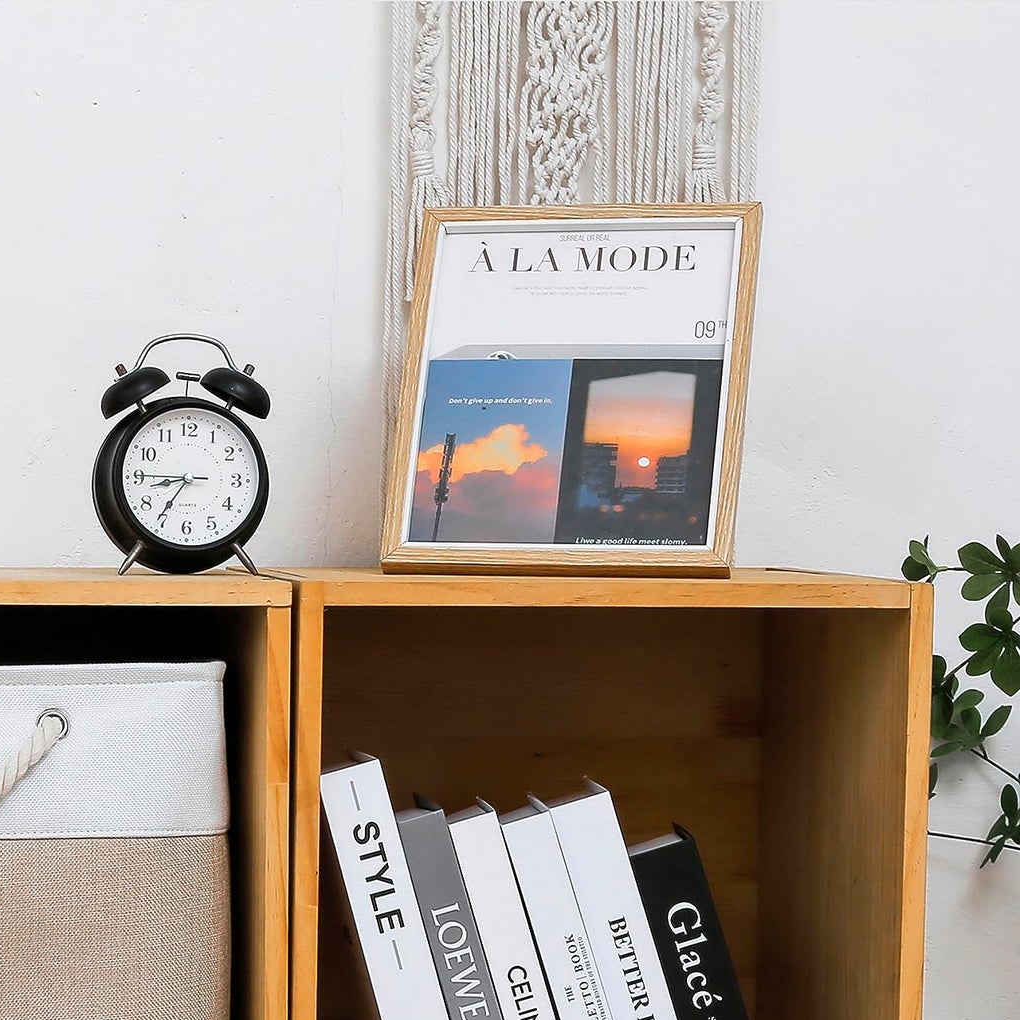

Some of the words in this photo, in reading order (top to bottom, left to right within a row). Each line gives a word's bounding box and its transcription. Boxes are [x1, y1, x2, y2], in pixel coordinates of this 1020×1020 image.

[468, 241, 497, 273] À
[508, 247, 562, 273] LA
[574, 244, 697, 273] MODE
[694, 320, 716, 339] 09
[468, 397, 483, 405] give
[527, 397, 543, 405] give
[158, 428, 172, 443] 11
[180, 422, 199, 437] 12
[210, 430, 215, 444] 1
[140, 446, 157, 462] 10
[223, 445, 235, 461] 2
[133, 469, 145, 486] 9
[230, 472, 242, 488] 3
[140, 494, 152, 511] 8
[221, 496, 233, 511] 4
[157, 512, 168, 528] 7
[181, 519, 192, 535] 6
[206, 515, 217, 530] 5
[624, 537, 638, 545] life
[353, 821, 405, 934] STYLE
[564, 934, 583, 972] BOOK
[668, 902, 722, 1009] Glacé
[608, 916, 649, 1011] BETTER
[564, 985, 575, 1002] THE
